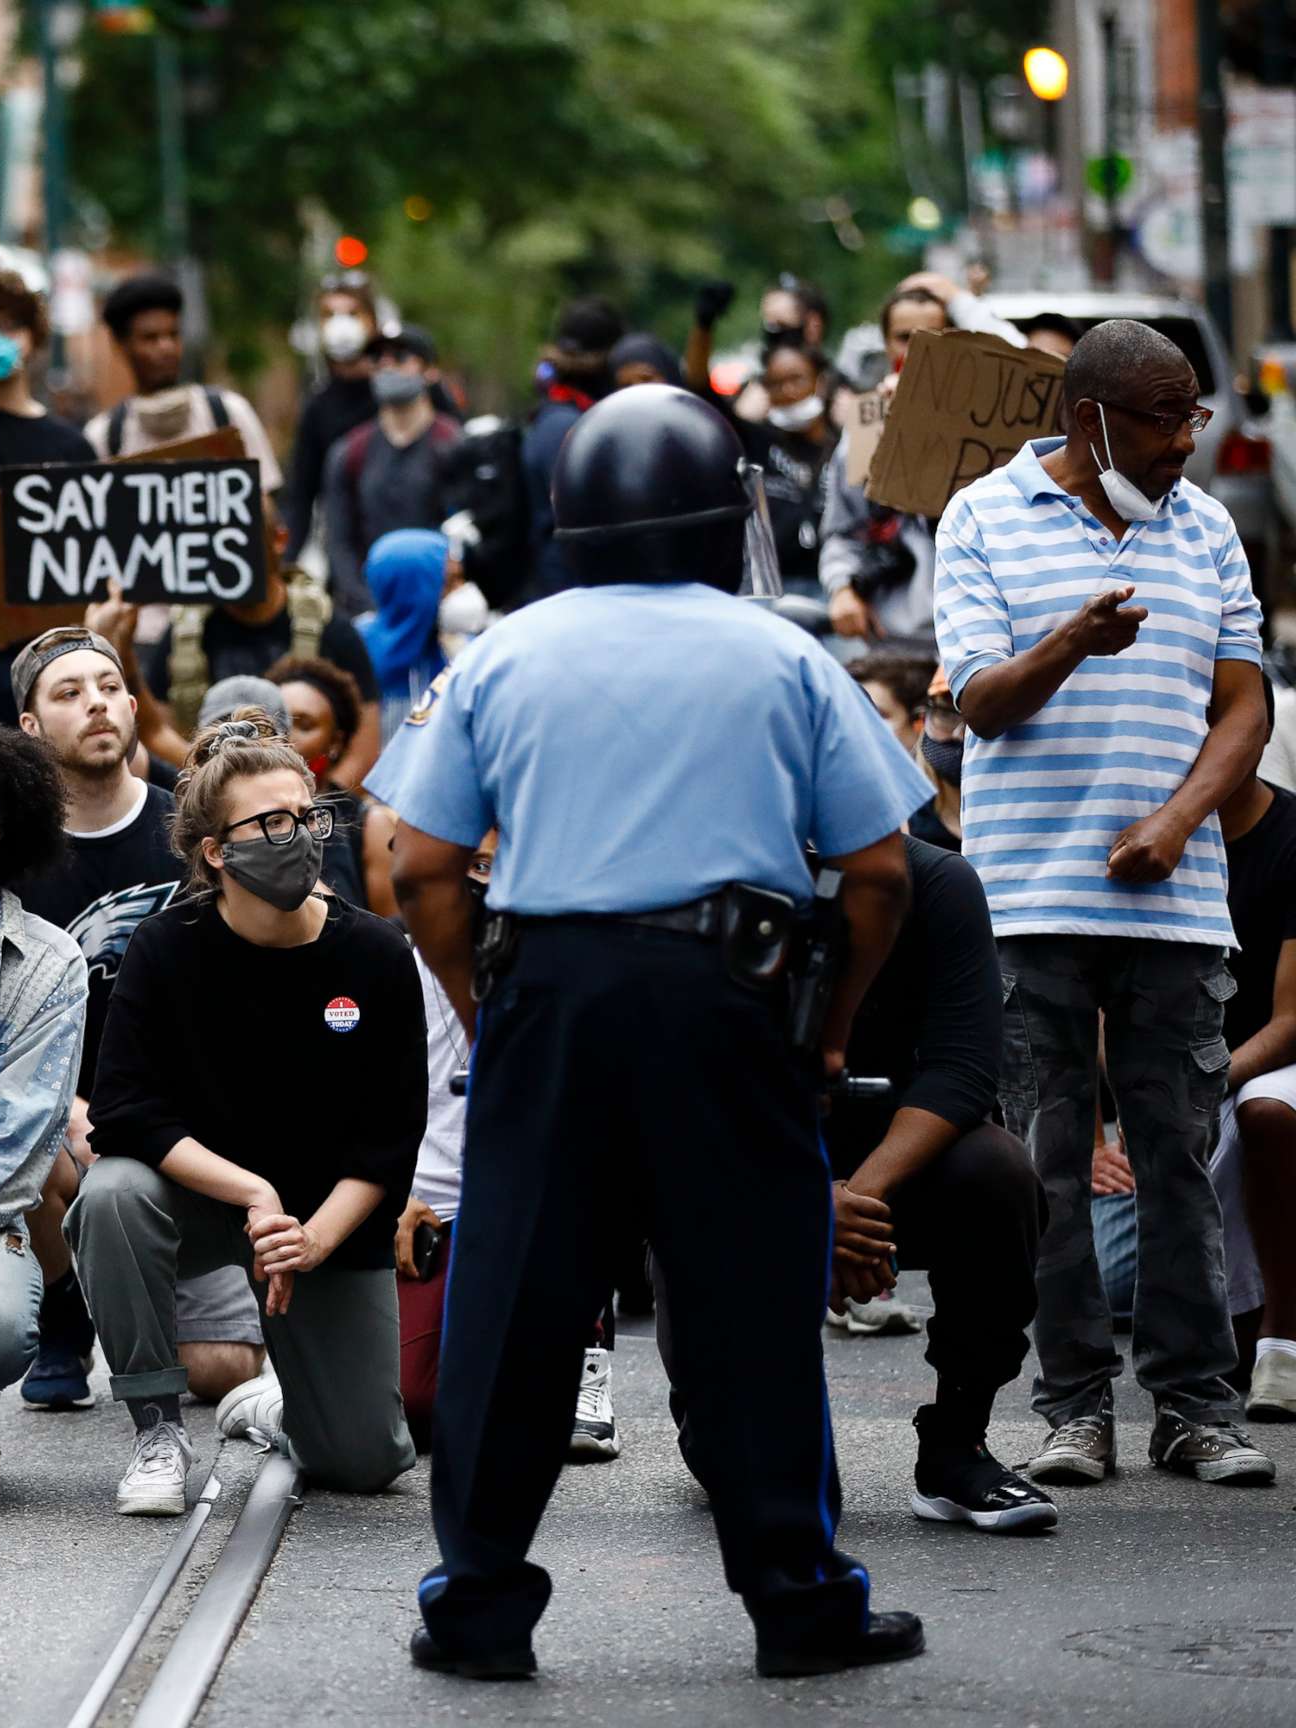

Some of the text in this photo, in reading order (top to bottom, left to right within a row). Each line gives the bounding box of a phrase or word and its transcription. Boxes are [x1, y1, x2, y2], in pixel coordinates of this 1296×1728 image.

[969, 351, 1068, 432] JUSTI
[12, 467, 253, 534] SAY THEIR
[27, 527, 253, 602] NAMES
[329, 1010, 355, 1018] VOTED
